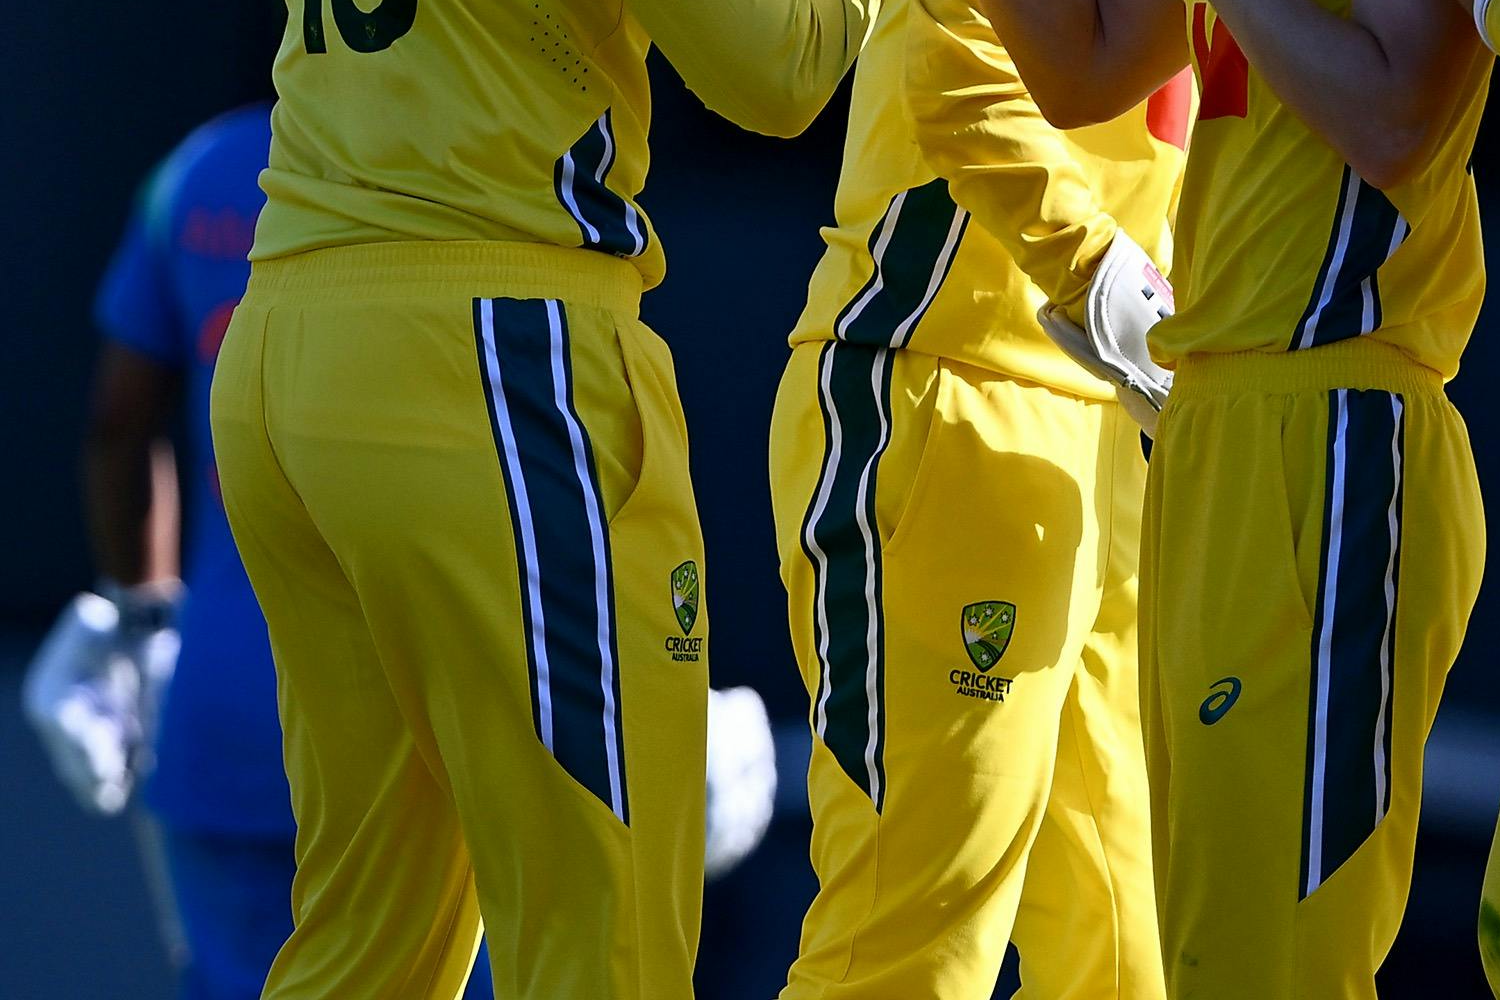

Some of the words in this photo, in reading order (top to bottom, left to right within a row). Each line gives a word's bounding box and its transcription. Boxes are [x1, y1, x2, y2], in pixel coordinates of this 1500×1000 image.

[665, 637, 703, 653] CRICKET
[672, 653, 699, 662] AUSTRALIA
[949, 670, 1013, 694] CRICKET
[957, 686, 1004, 702] AUSTRALIA
